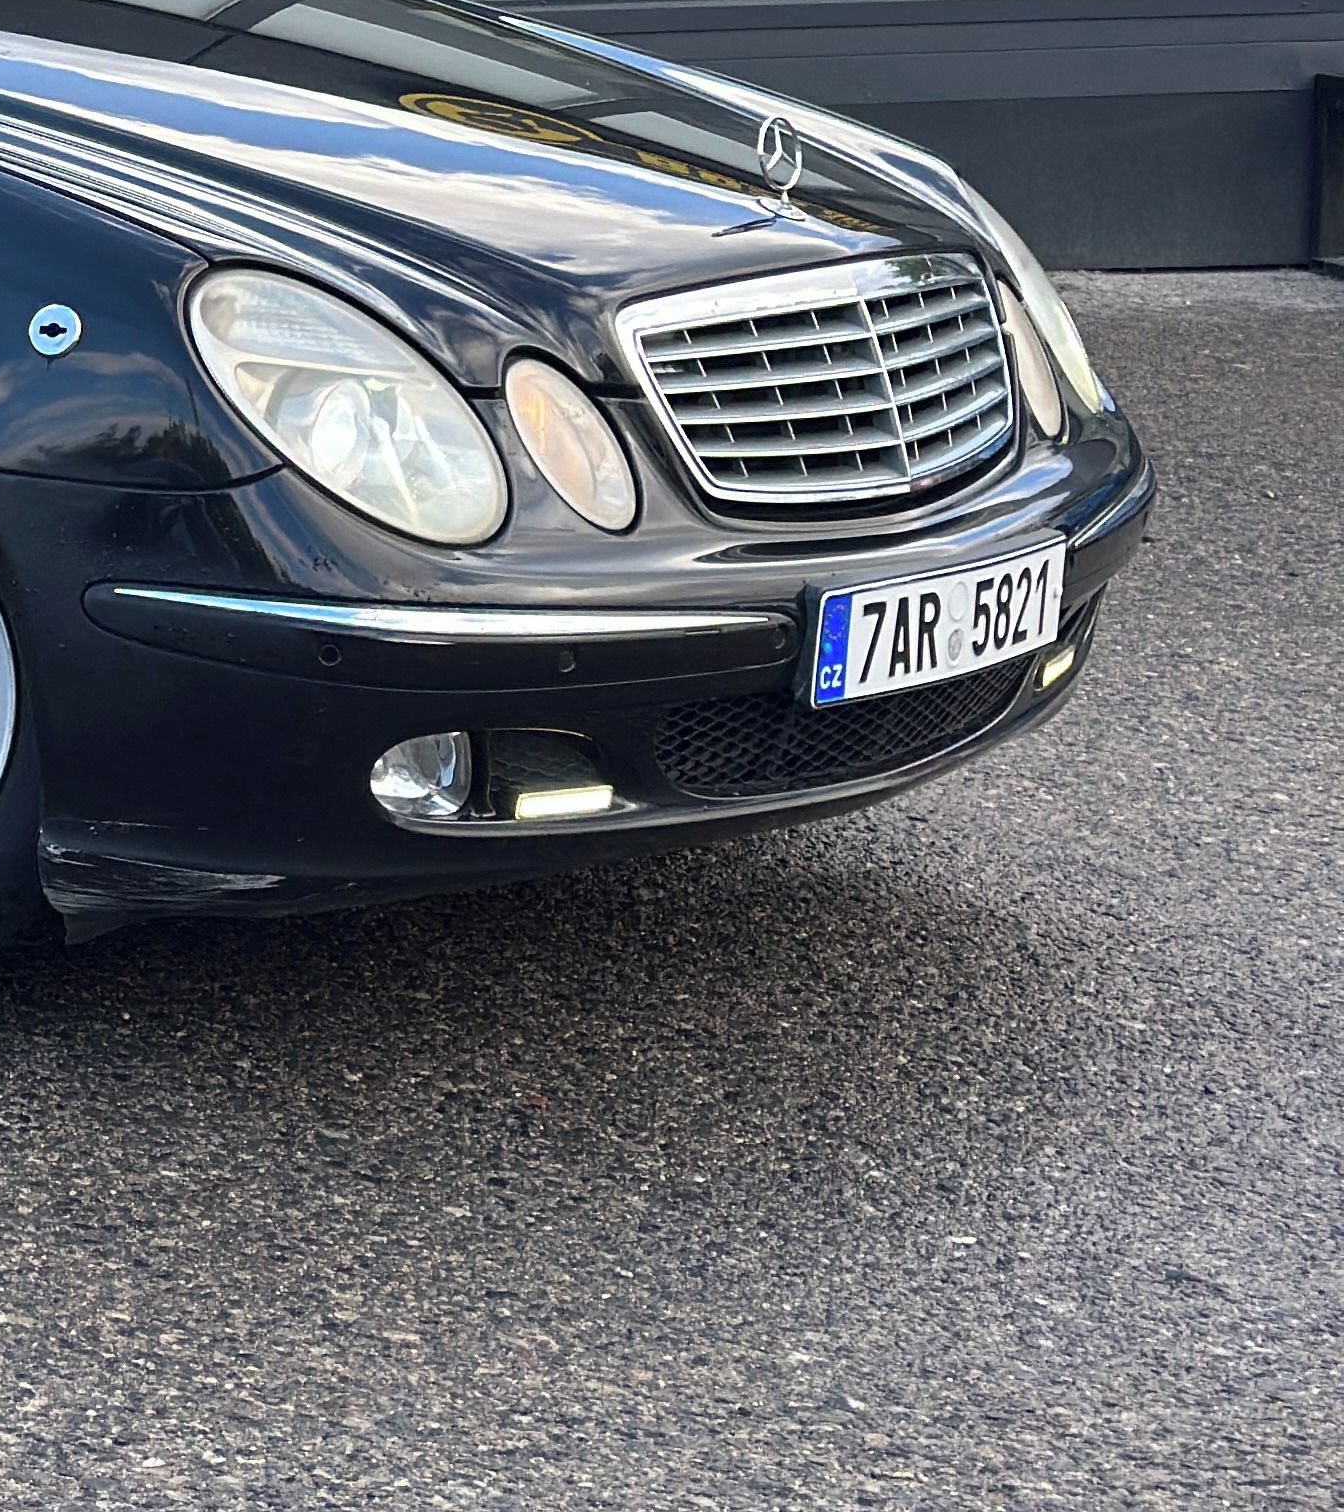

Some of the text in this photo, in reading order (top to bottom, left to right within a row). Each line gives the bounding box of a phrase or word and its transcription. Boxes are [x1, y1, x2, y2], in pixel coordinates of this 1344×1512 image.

[858, 559, 1051, 685] 7AR 5821
[819, 663, 844, 691] CZ
